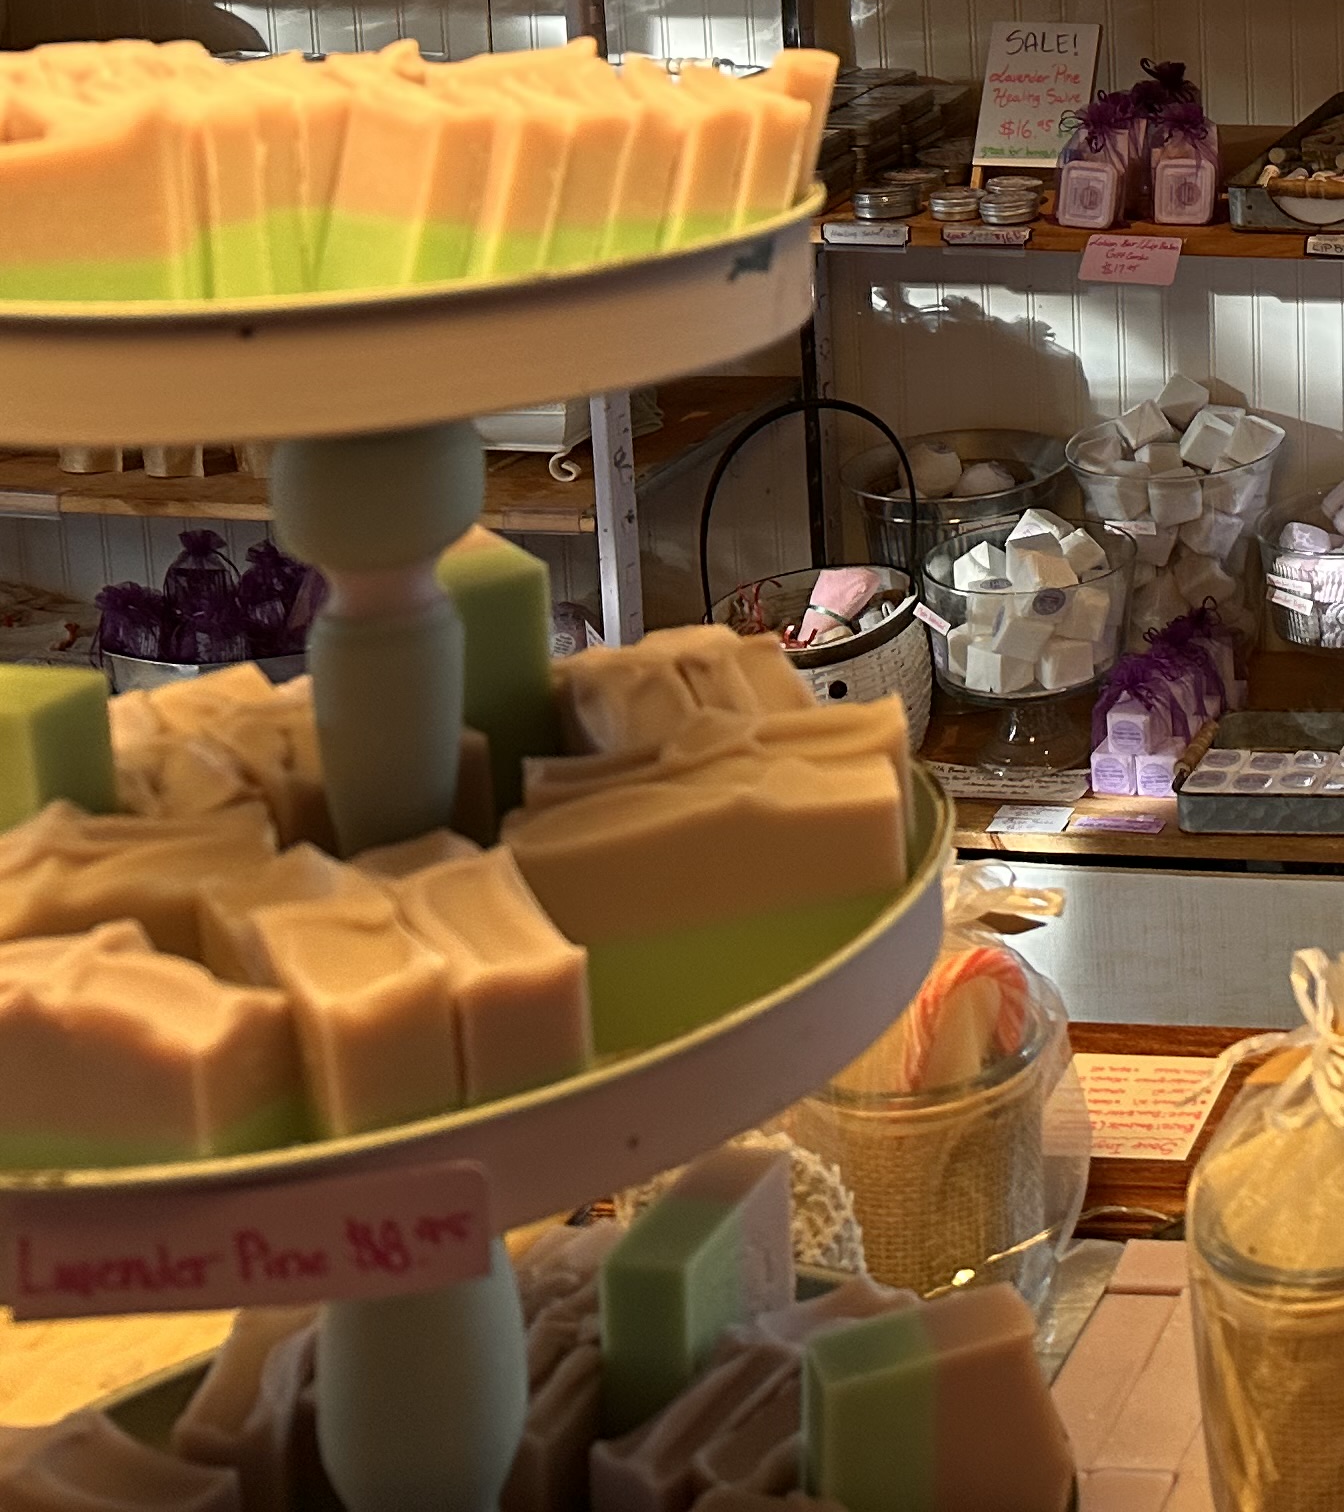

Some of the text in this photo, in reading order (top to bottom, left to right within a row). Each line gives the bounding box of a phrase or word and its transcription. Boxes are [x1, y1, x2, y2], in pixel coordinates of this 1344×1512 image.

[1006, 29, 1079, 56] SALE!
[989, 63, 1081, 84] Lavender Pine
[993, 88, 1081, 108] Healing Salve
[16, 1235, 226, 1297] Lavender
[233, 1228, 328, 1283] Pine
